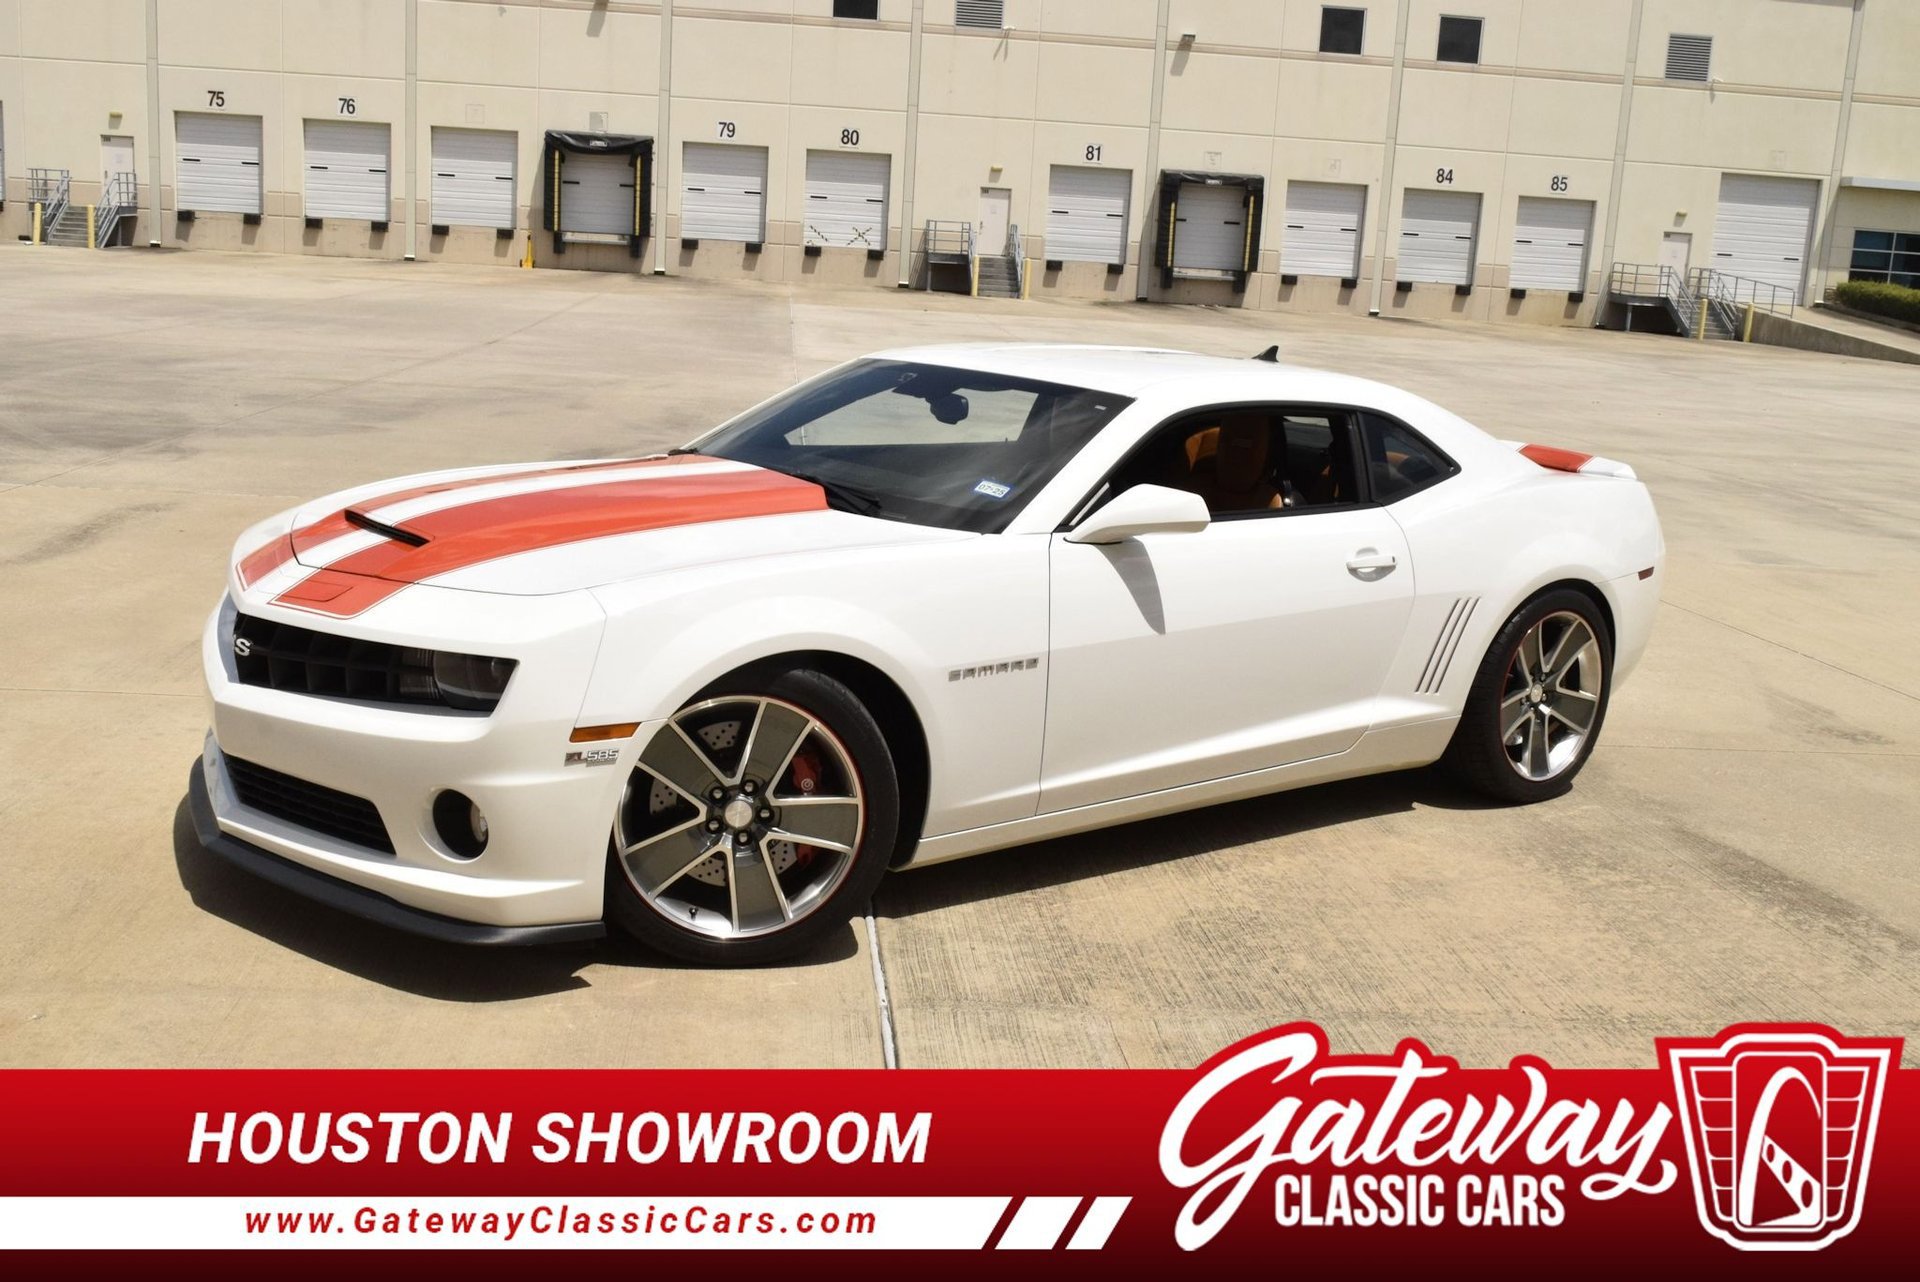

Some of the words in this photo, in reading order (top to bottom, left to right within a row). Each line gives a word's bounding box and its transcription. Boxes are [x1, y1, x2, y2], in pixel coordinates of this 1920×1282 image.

[207, 90, 225, 108] 75
[338, 97, 356, 115] 76
[718, 121, 736, 139] 79
[840, 128, 860, 146] 80
[1085, 145, 1101, 162] 81
[1436, 168, 1454, 185] 84
[1550, 175, 1568, 192] 85
